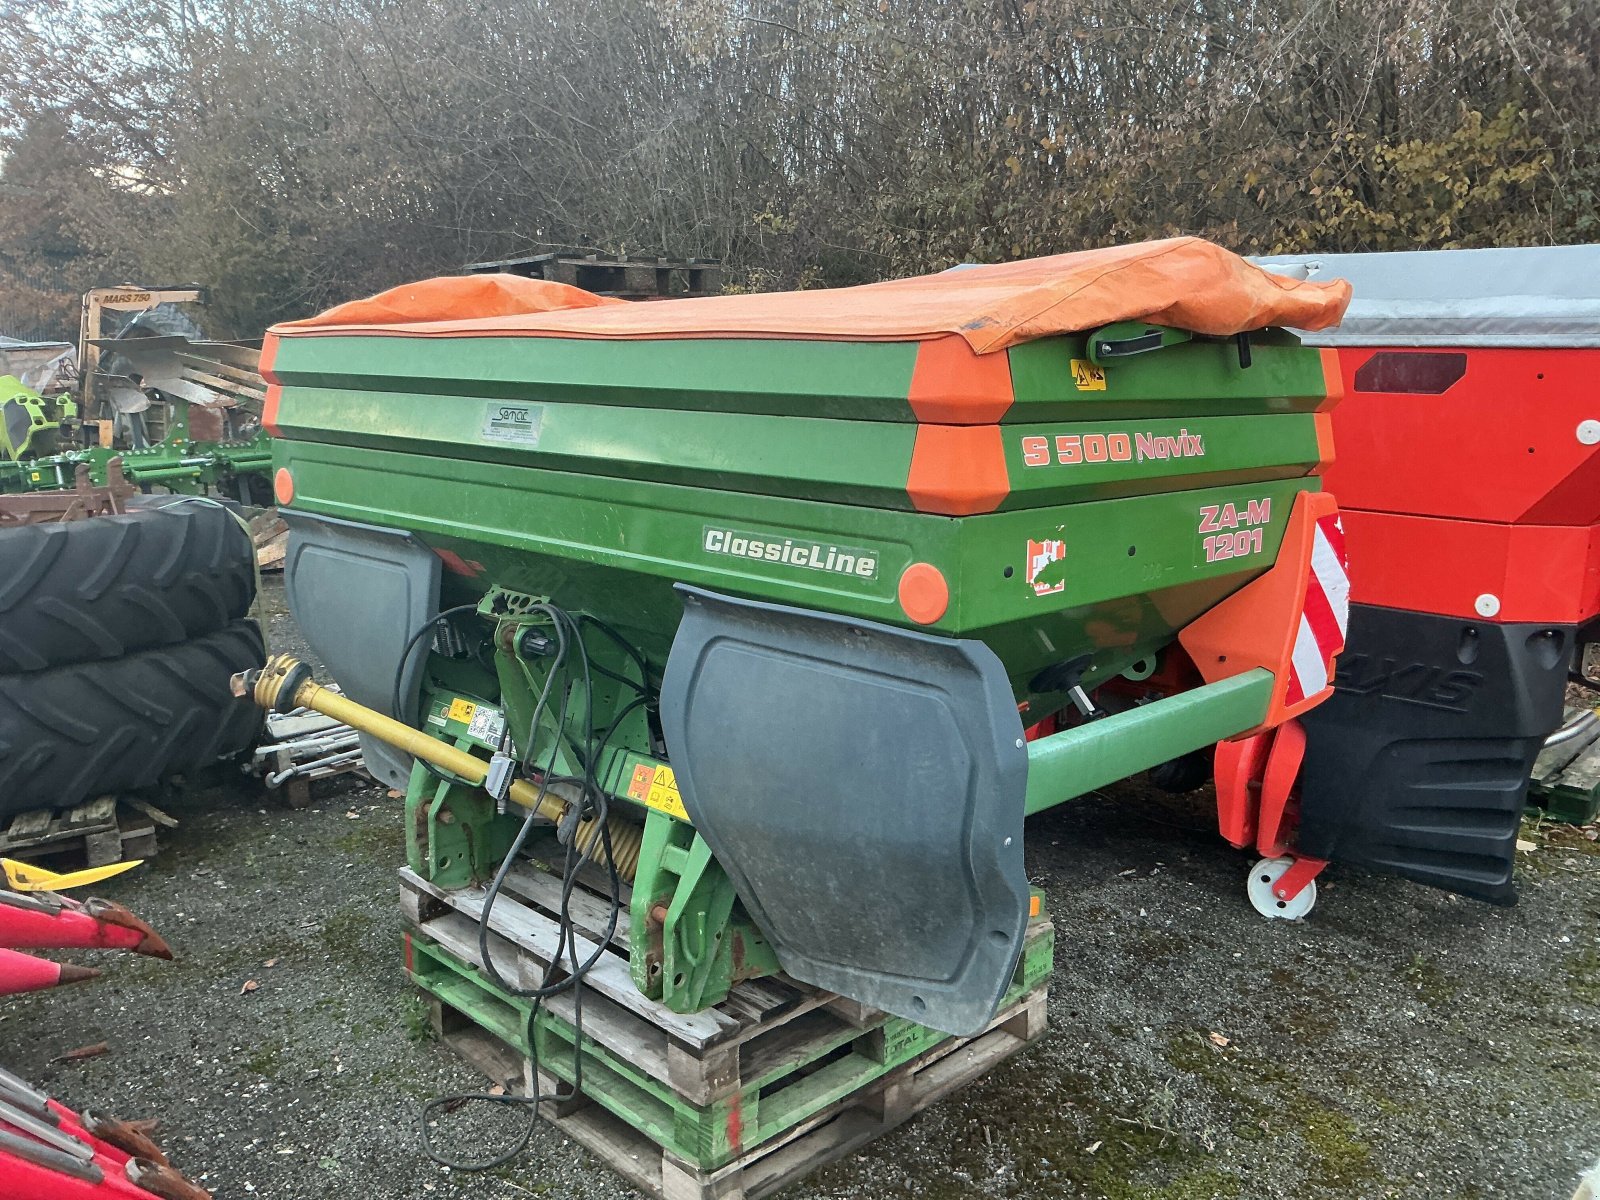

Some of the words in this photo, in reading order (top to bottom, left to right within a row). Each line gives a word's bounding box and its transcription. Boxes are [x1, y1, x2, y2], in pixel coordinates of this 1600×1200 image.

[103, 294, 132, 304] MARS
[133, 293, 151, 303] 750
[1022, 436, 1050, 467] S
[1055, 433, 1132, 464] 500
[1134, 428, 1205, 462] Novix
[1198, 497, 1271, 533] ZA-M
[705, 530, 876, 576] ClassicLine
[1202, 527, 1263, 562] 1201
